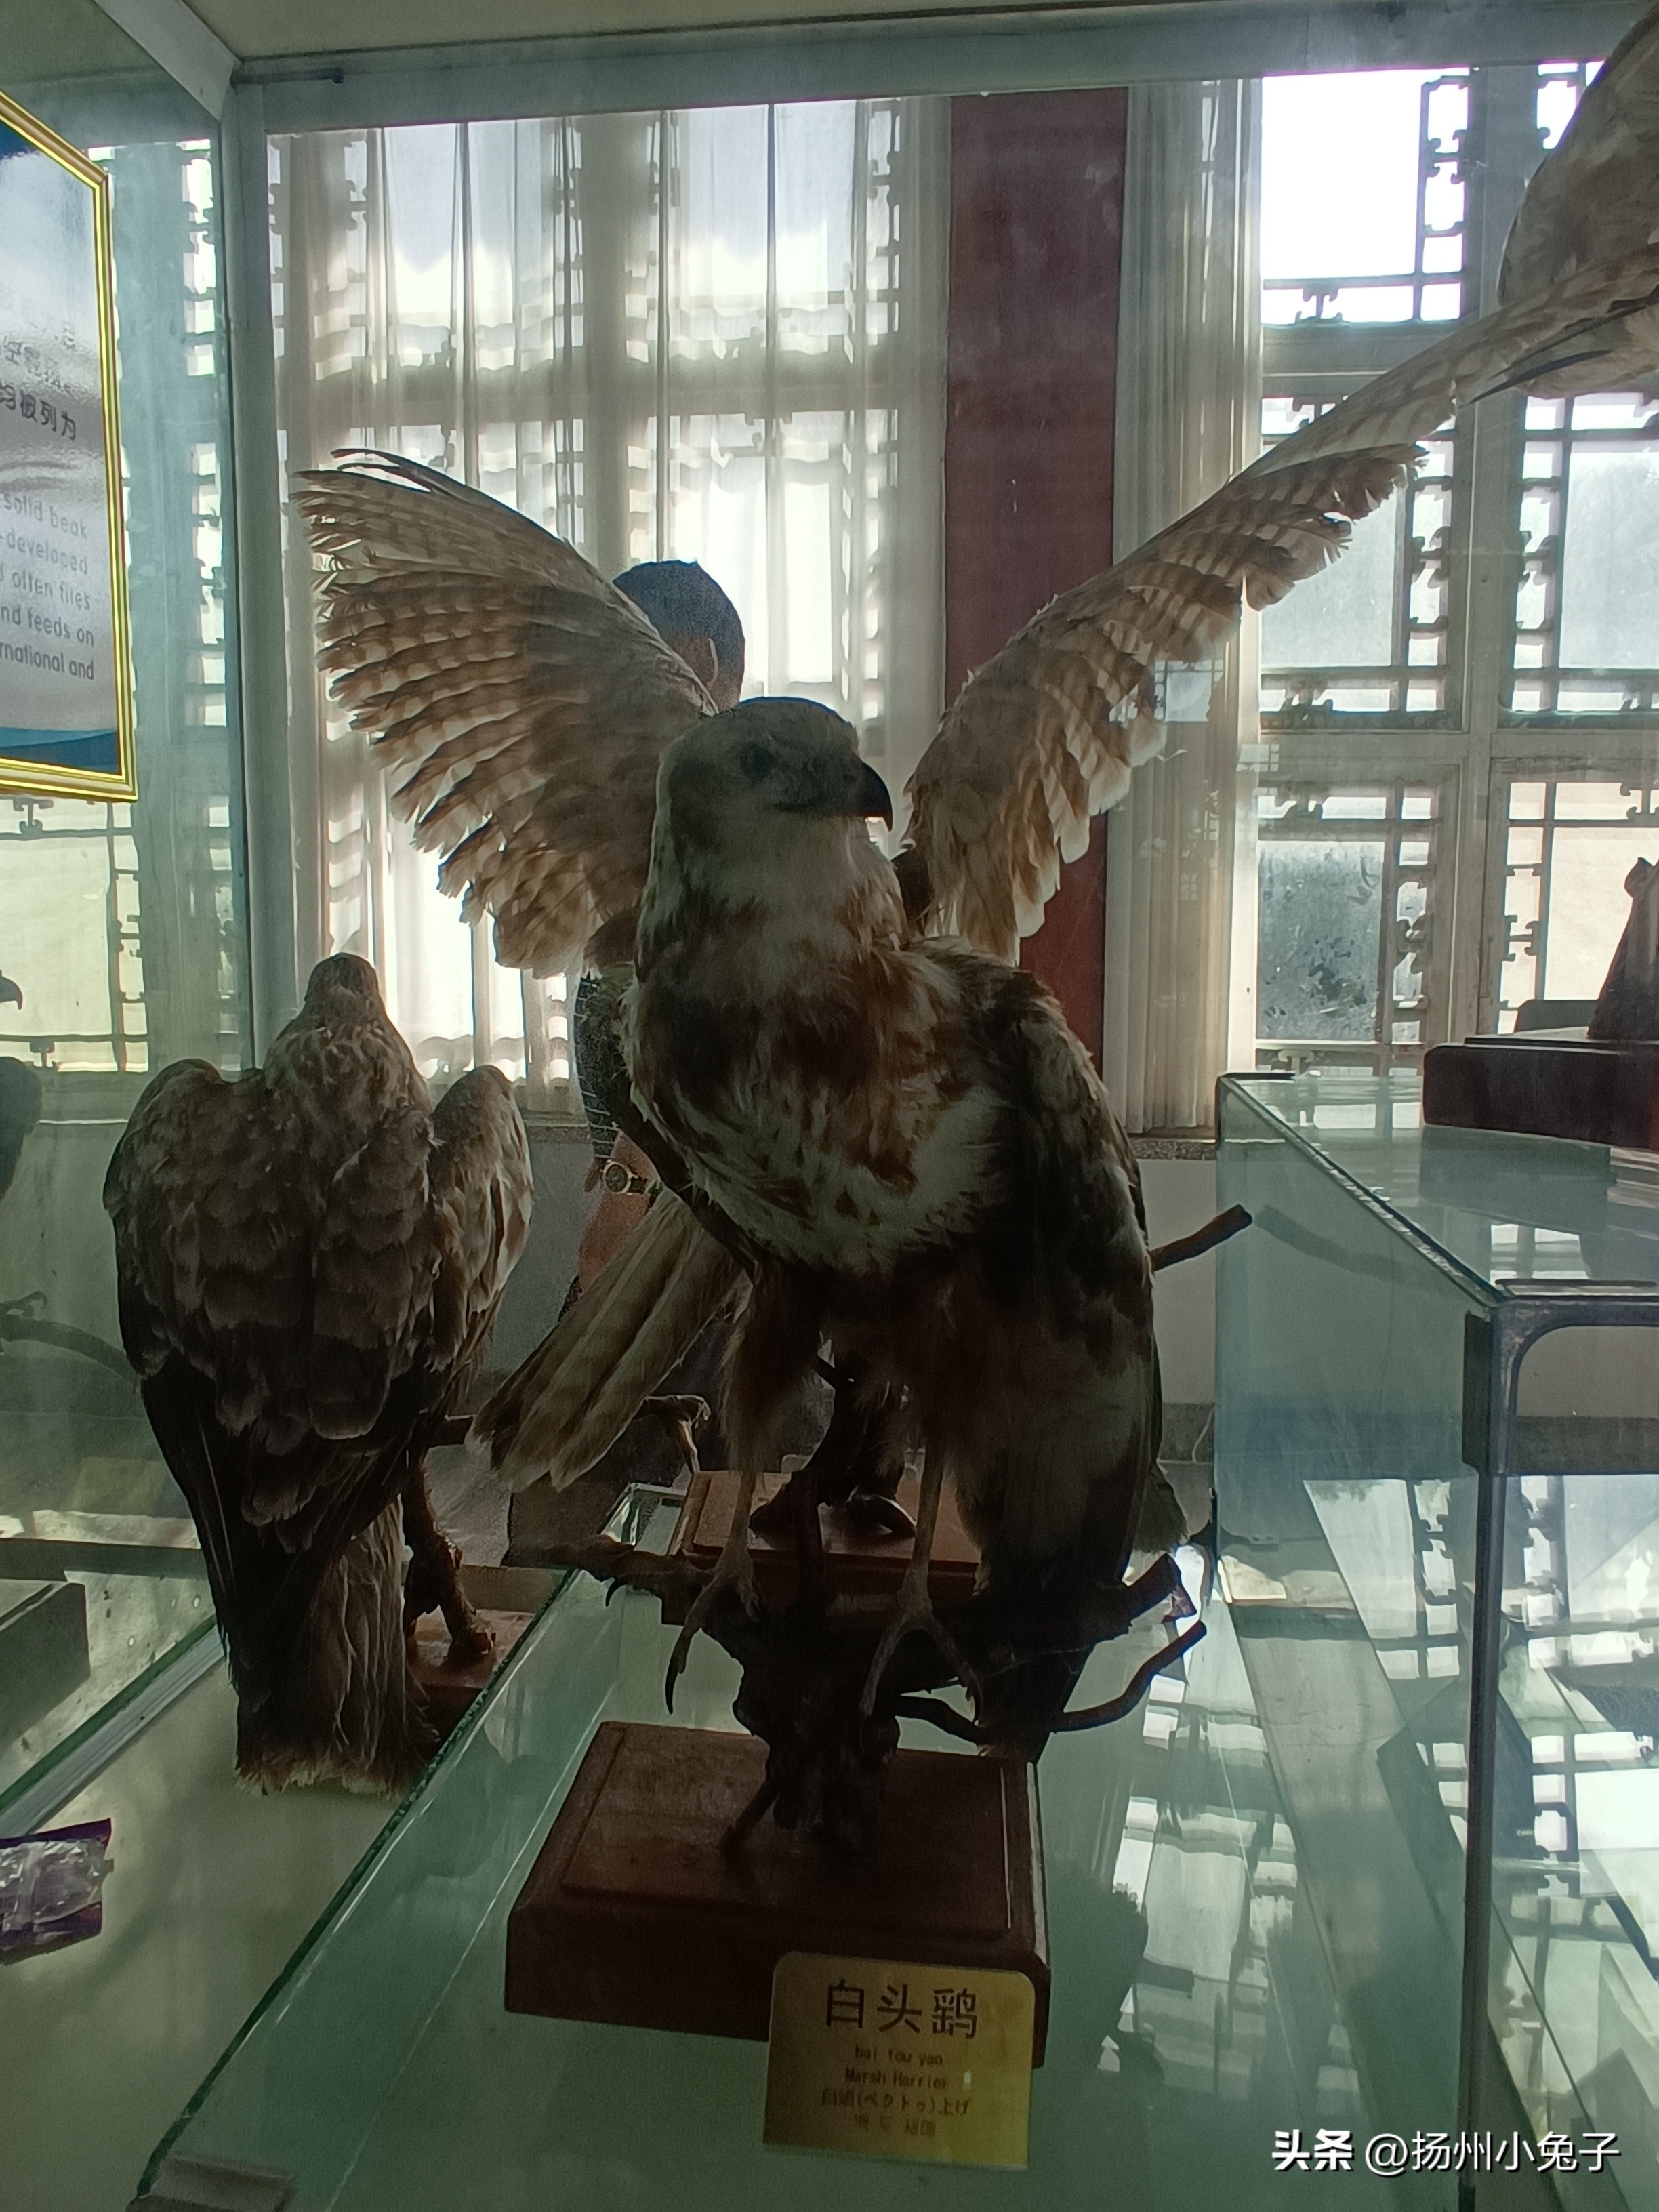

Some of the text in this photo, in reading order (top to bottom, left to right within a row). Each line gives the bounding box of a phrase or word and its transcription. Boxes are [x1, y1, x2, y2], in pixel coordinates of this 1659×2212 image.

[4, 493, 87, 539] solid beak
[12, 569, 54, 597] often
[28, 606, 70, 639] feeds
[77, 628, 94, 647] on
[69, 659, 94, 680] and
[826, 1978, 977, 2039] 白头鹞
